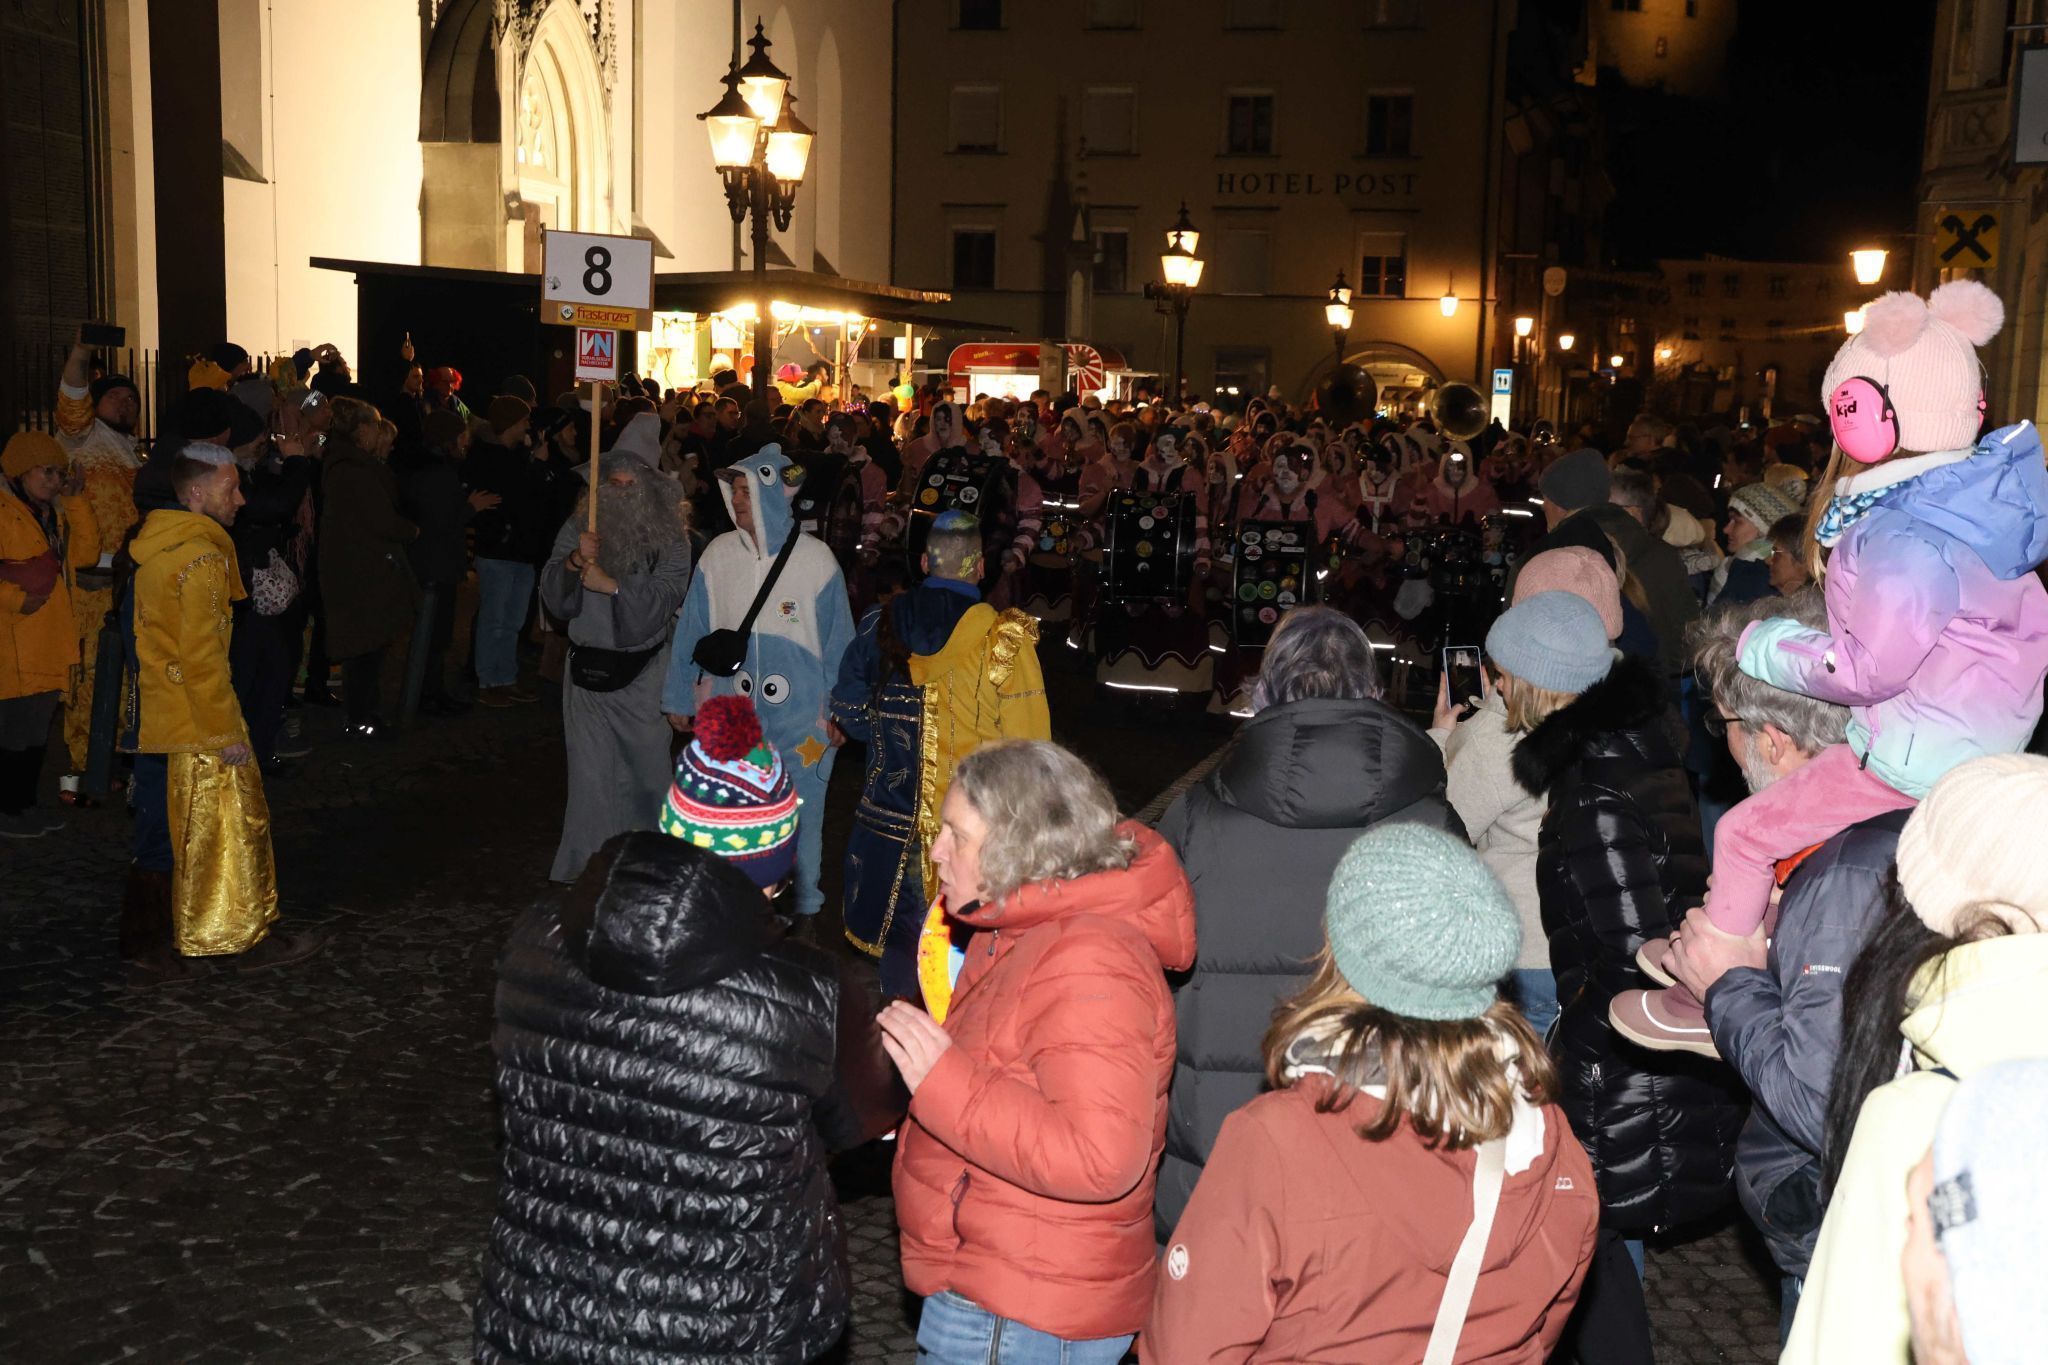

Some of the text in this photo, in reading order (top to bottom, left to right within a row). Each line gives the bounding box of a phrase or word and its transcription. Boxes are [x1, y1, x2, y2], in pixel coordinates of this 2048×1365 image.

[1217, 173, 1418, 195] HOTEL POST
[583, 246, 612, 295] 8
[581, 332, 612, 356] VN
[1836, 401, 1857, 417] kid
